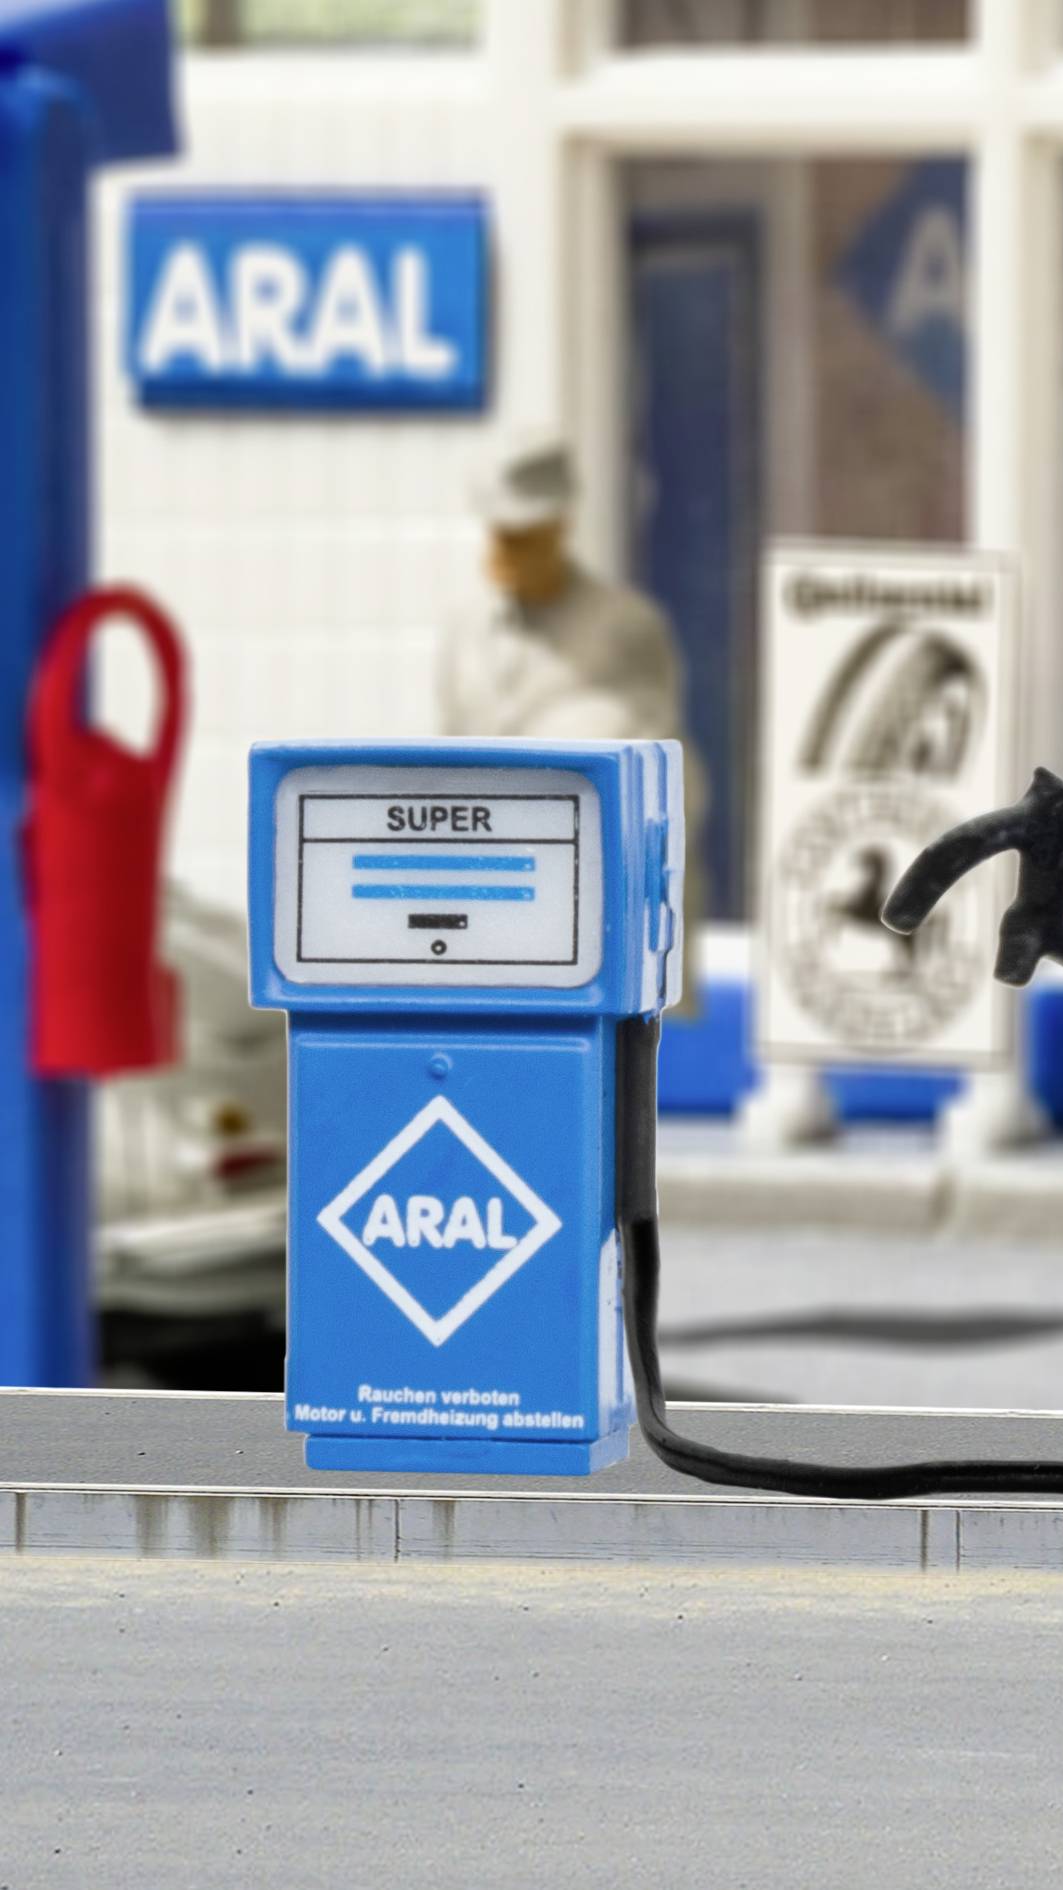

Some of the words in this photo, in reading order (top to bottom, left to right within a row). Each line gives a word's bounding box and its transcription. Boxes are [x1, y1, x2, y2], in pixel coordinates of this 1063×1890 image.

[139, 240, 461, 379] ARAL
[387, 805, 492, 832] SUPER
[362, 1194, 518, 1249] ARAL
[358, 1384, 436, 1404] Rauchen
[441, 1388, 520, 1406] verboten
[294, 1404, 345, 1422] Motor
[350, 1410, 366, 1423] u.
[371, 1407, 498, 1430] Fremdheizung
[502, 1412, 584, 1429] abstellen
